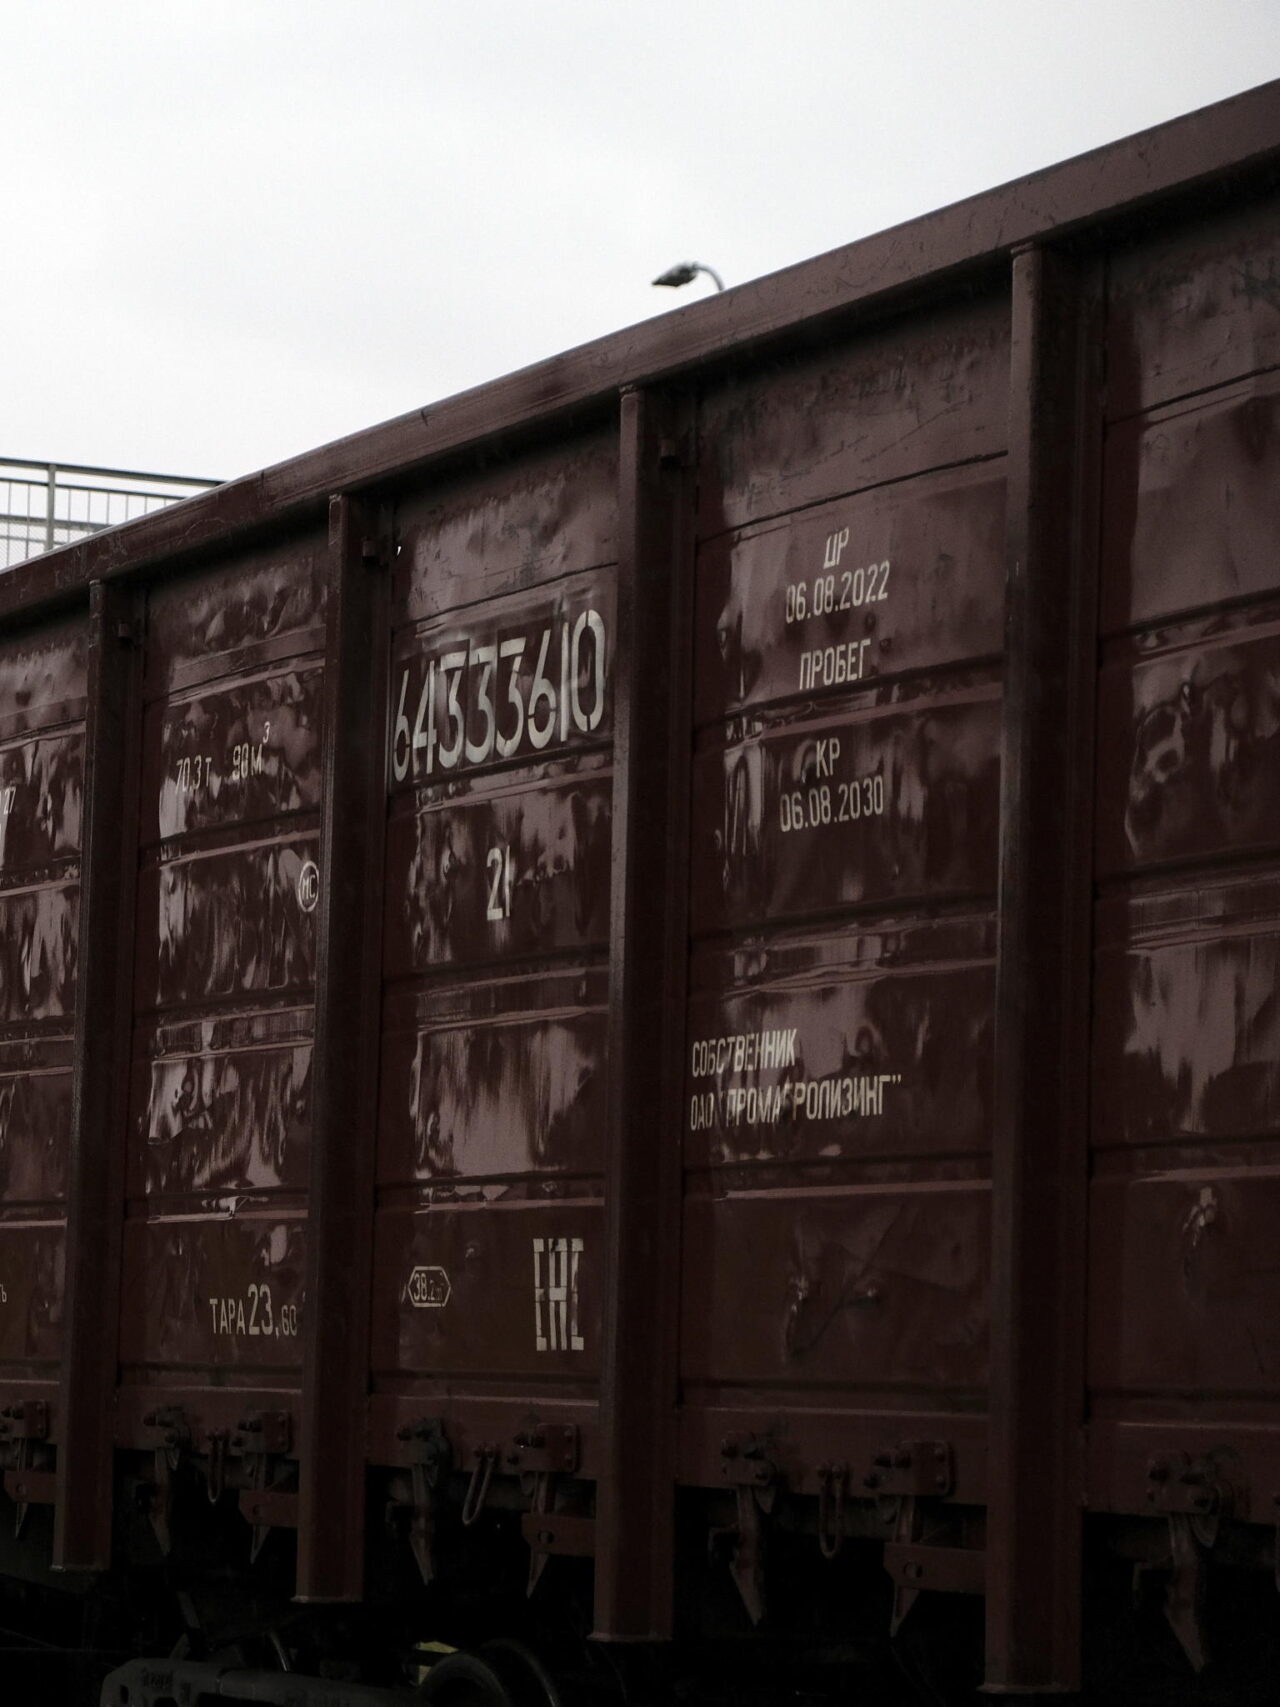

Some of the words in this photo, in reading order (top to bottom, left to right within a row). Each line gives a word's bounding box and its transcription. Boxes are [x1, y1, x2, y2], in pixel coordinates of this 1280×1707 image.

[785, 560, 891, 625] 06.08.2022
[799, 638, 872, 691] ПРОБЕГ
[392, 608, 606, 782] 64333610
[815, 736, 841, 778] КР
[3, 785, 17, 815] 27
[779, 775, 885, 833] 06.08.2030
[485, 844, 511, 922] 21
[691, 1028, 798, 1079] СОБСТВЕННИК
[690, 1090, 714, 1132] ОАО
[209, 1298, 246, 1335] ТАРА
